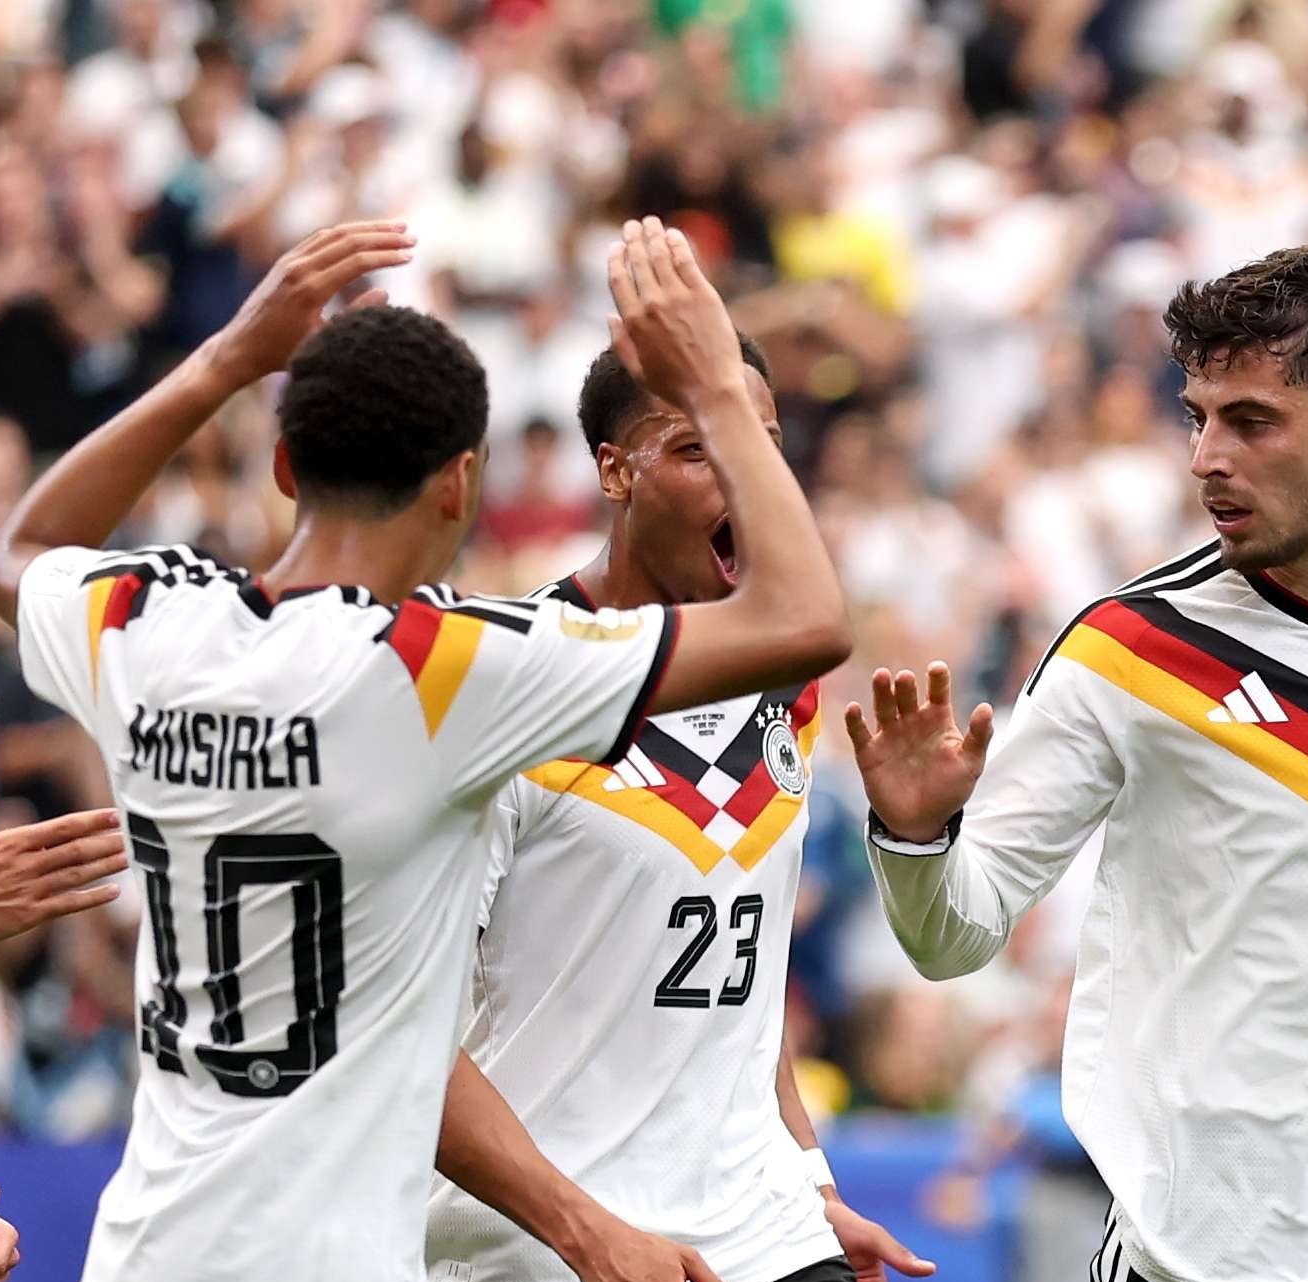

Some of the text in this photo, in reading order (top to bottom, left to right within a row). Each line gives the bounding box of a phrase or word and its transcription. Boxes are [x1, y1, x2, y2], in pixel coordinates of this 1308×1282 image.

[128, 703, 322, 791] MUSIALA
[128, 811, 346, 1098] 10
[653, 894, 764, 1009] 23
